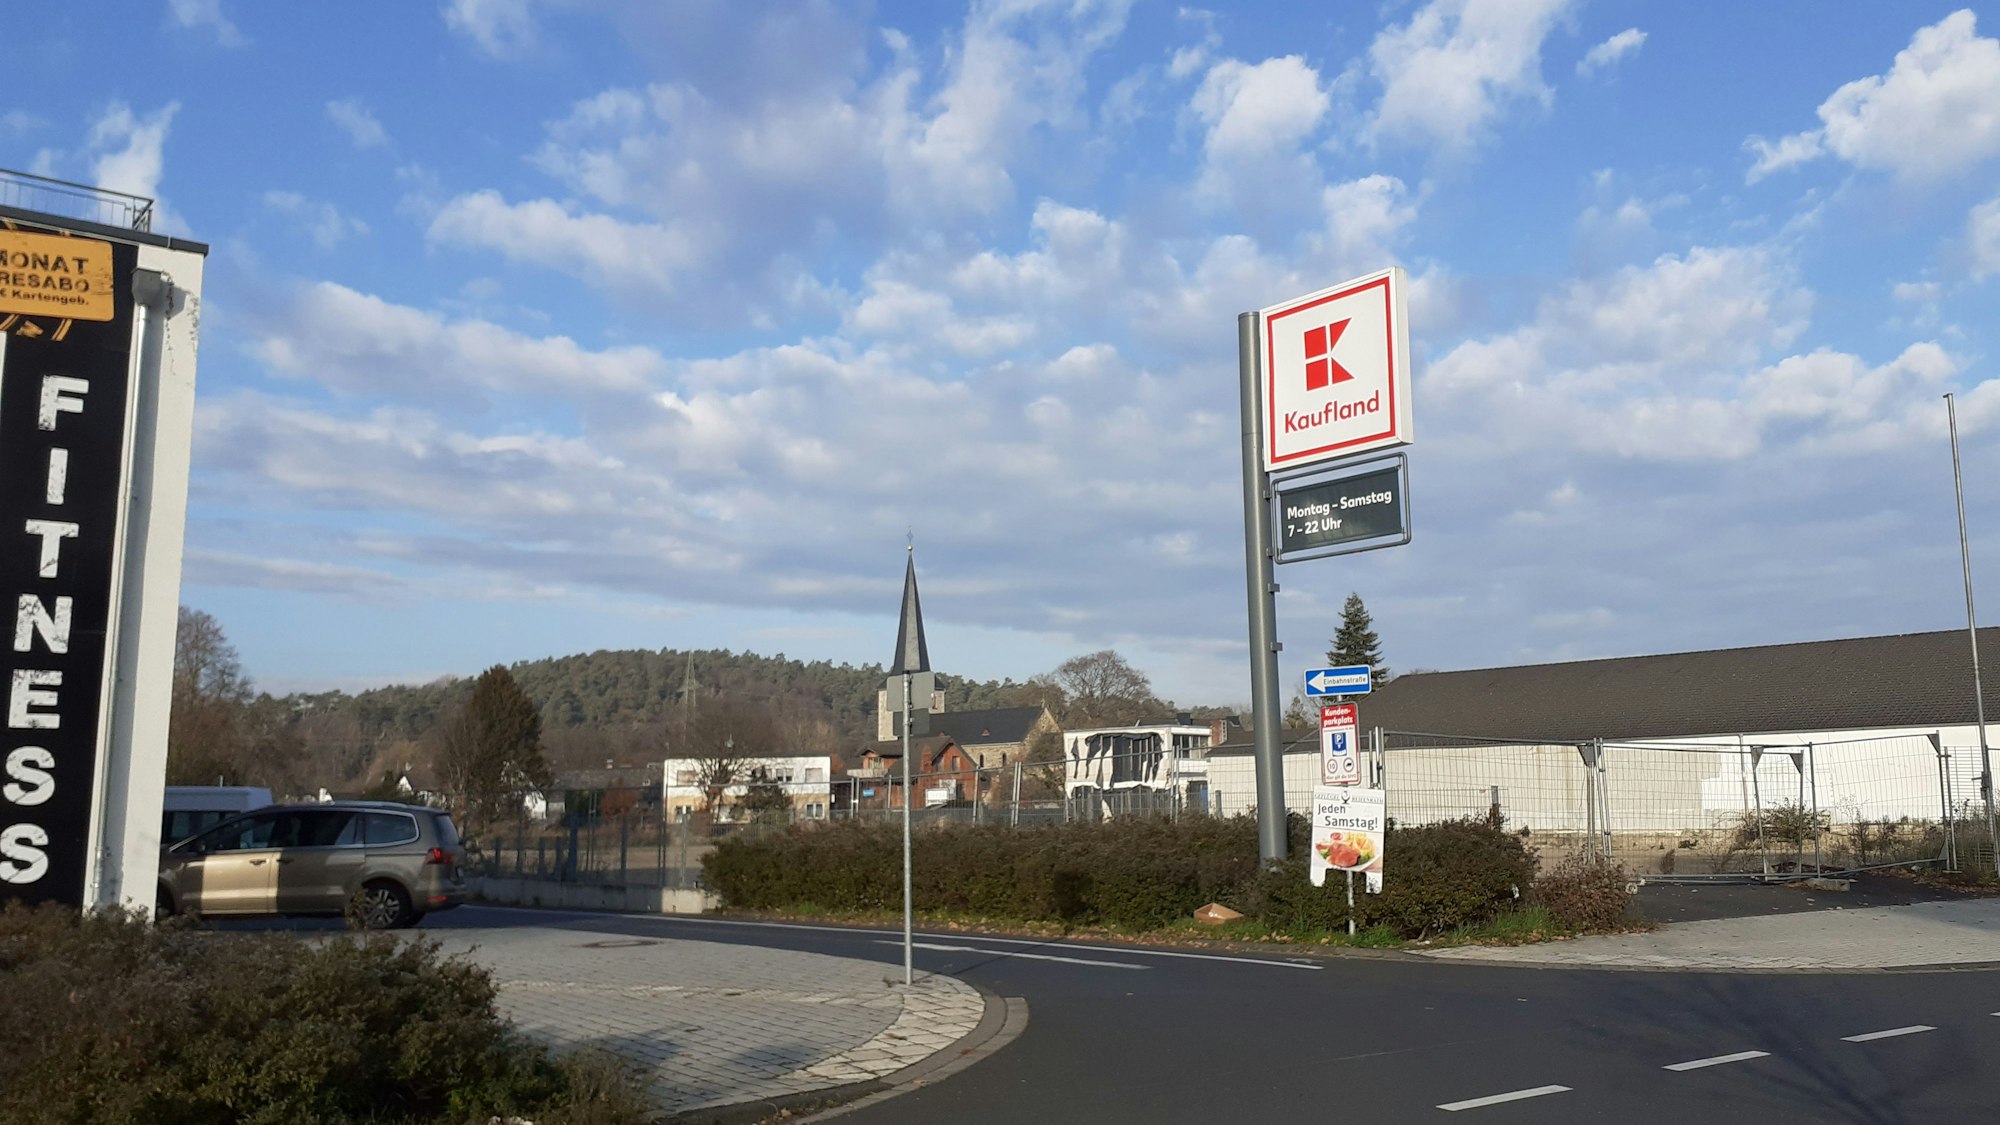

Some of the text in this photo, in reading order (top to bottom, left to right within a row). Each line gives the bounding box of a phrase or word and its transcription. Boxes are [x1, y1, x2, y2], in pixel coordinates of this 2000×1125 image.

[12, 289, 90, 306] Kartengeb.
[1284, 389, 1380, 434] Kaufland
[1287, 503, 1331, 520] Montag
[1340, 491, 1392, 510] Samstag
[1288, 524, 1295, 538] 7
[1304, 521, 1319, 535] 22
[1321, 518, 1343, 531] Uhr
[0, 374, 90, 885] FITNESS
[1323, 676, 1367, 686] Einbahnstraße
[1324, 707, 1352, 717] Kunden-
[1323, 715, 1354, 727] parkplatz
[1318, 803, 1346, 815] Jeden
[1325, 815, 1378, 831] Samstag!
